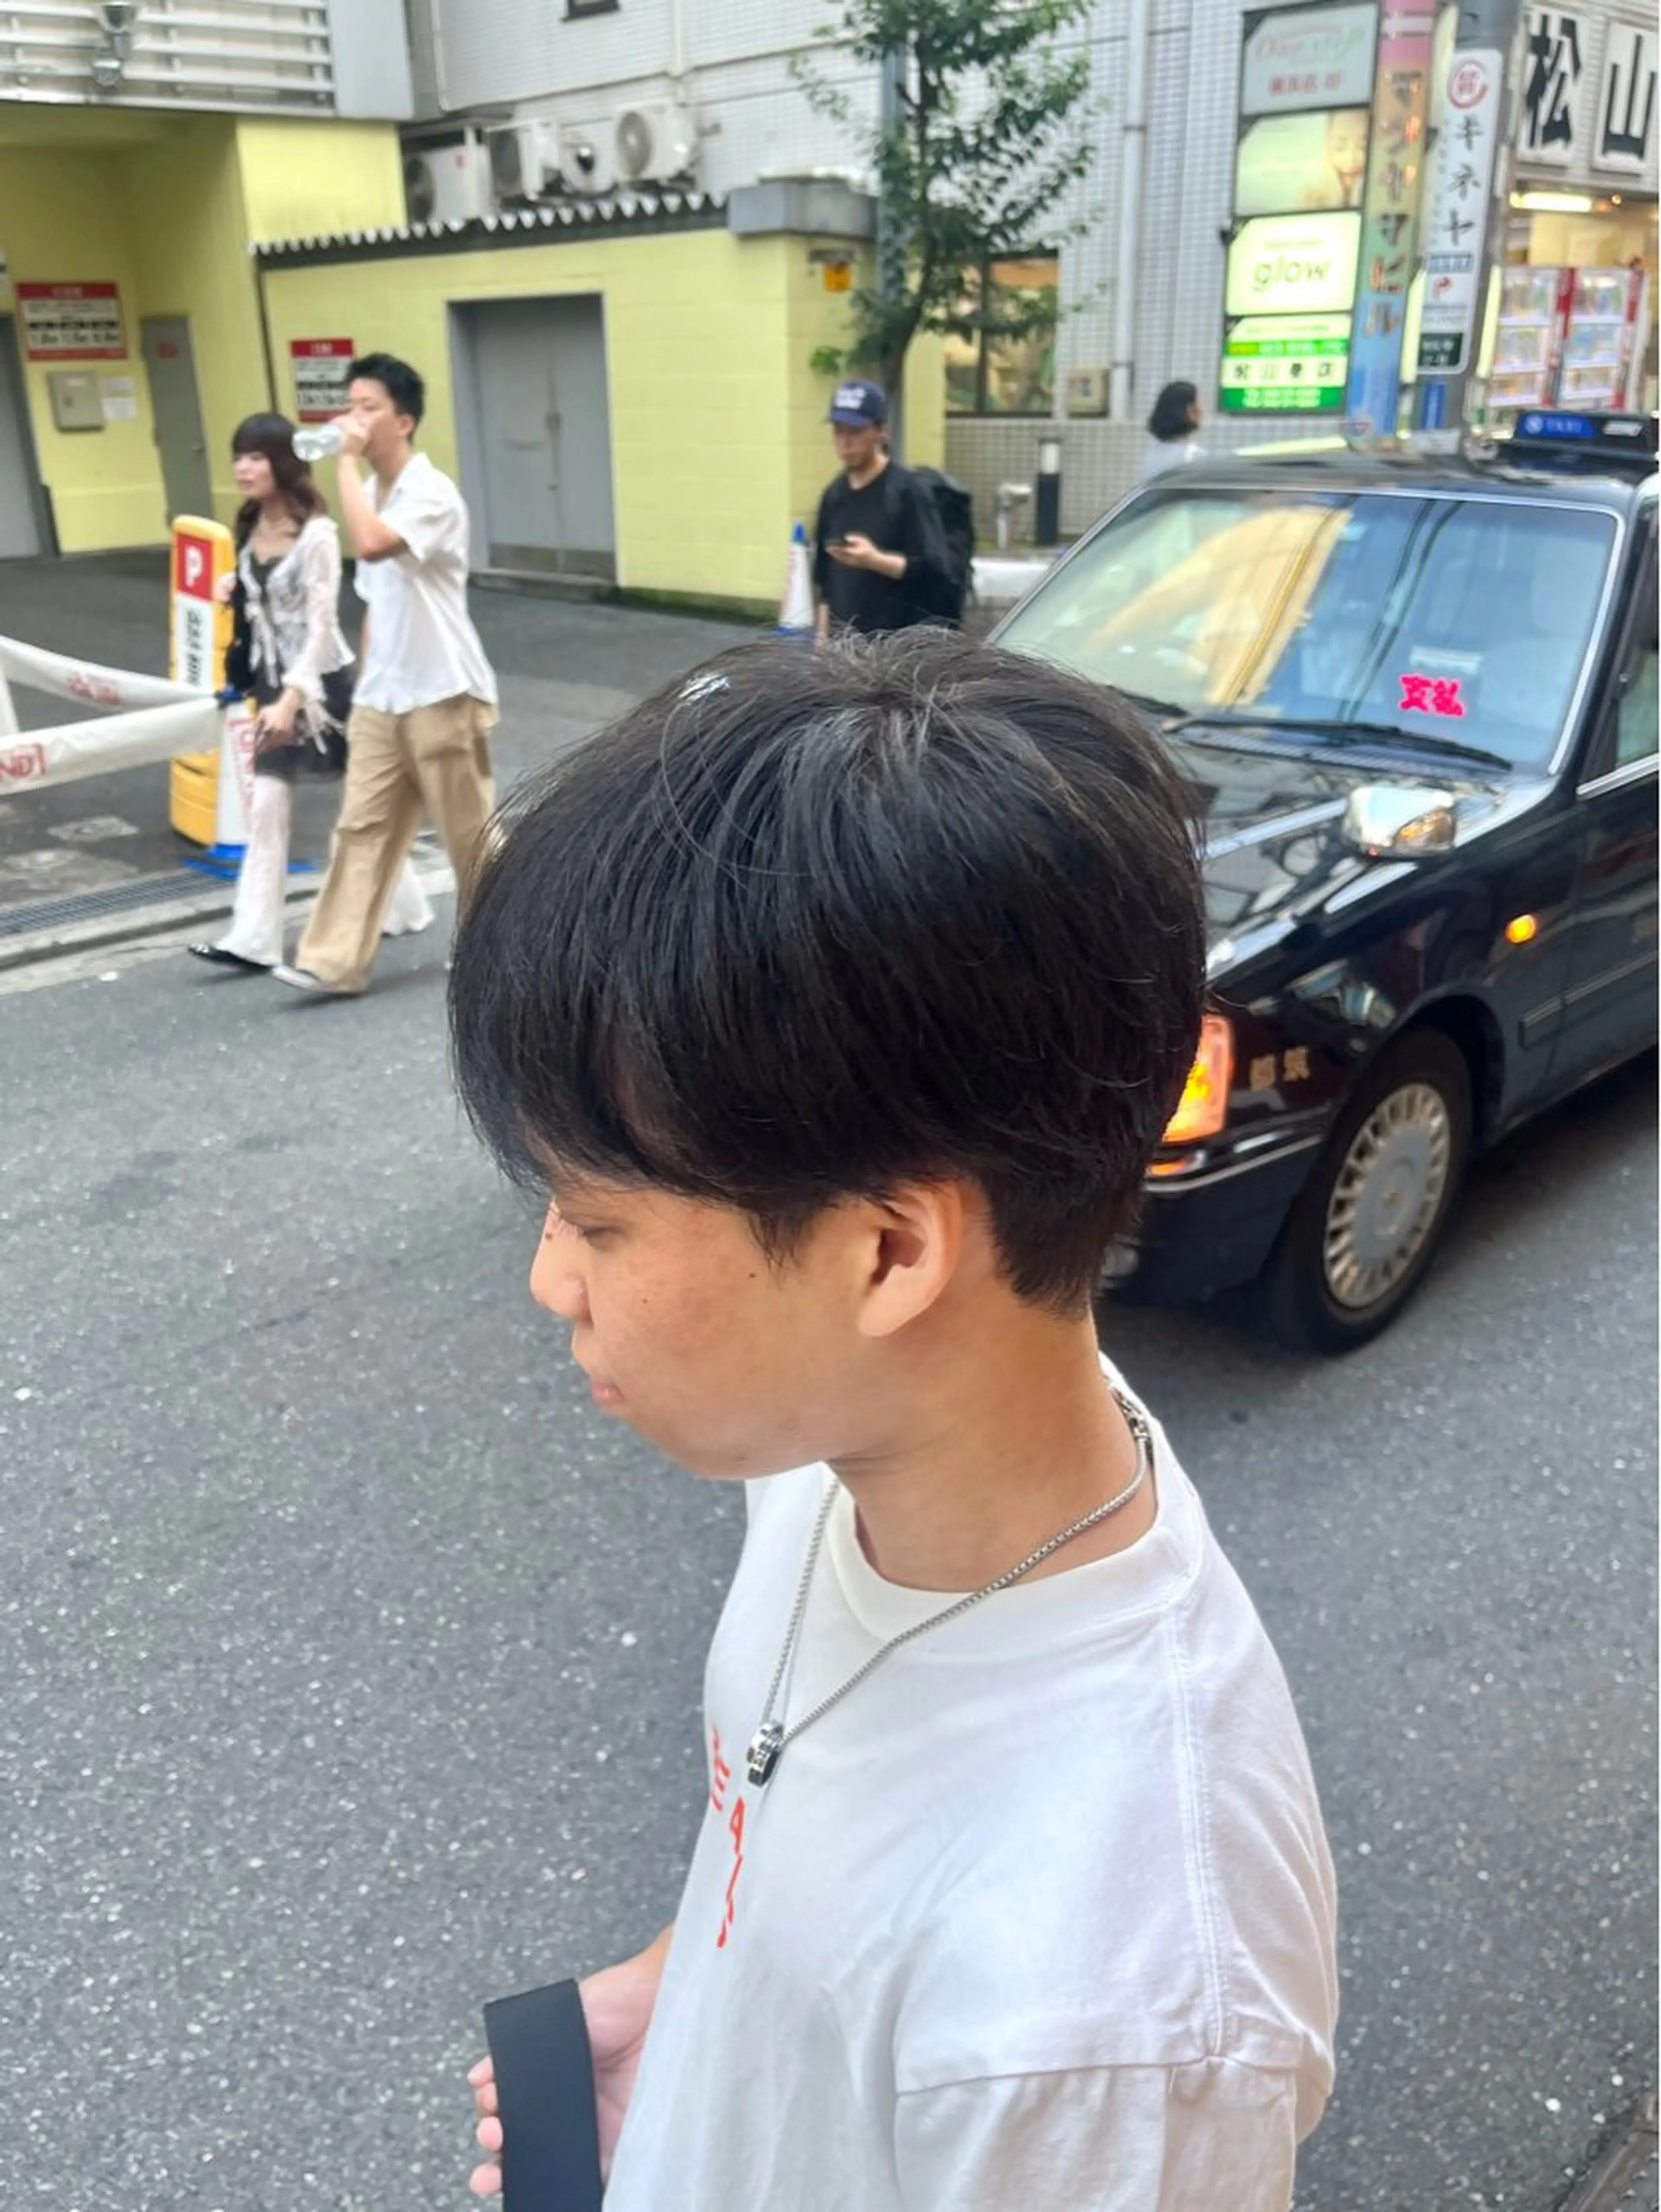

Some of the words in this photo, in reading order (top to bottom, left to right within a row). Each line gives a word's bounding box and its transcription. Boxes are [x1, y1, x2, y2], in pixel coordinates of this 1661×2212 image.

[1443, 115, 1484, 246] キネヤ
[1253, 255, 1331, 292] glow
[185, 545, 204, 587] P
